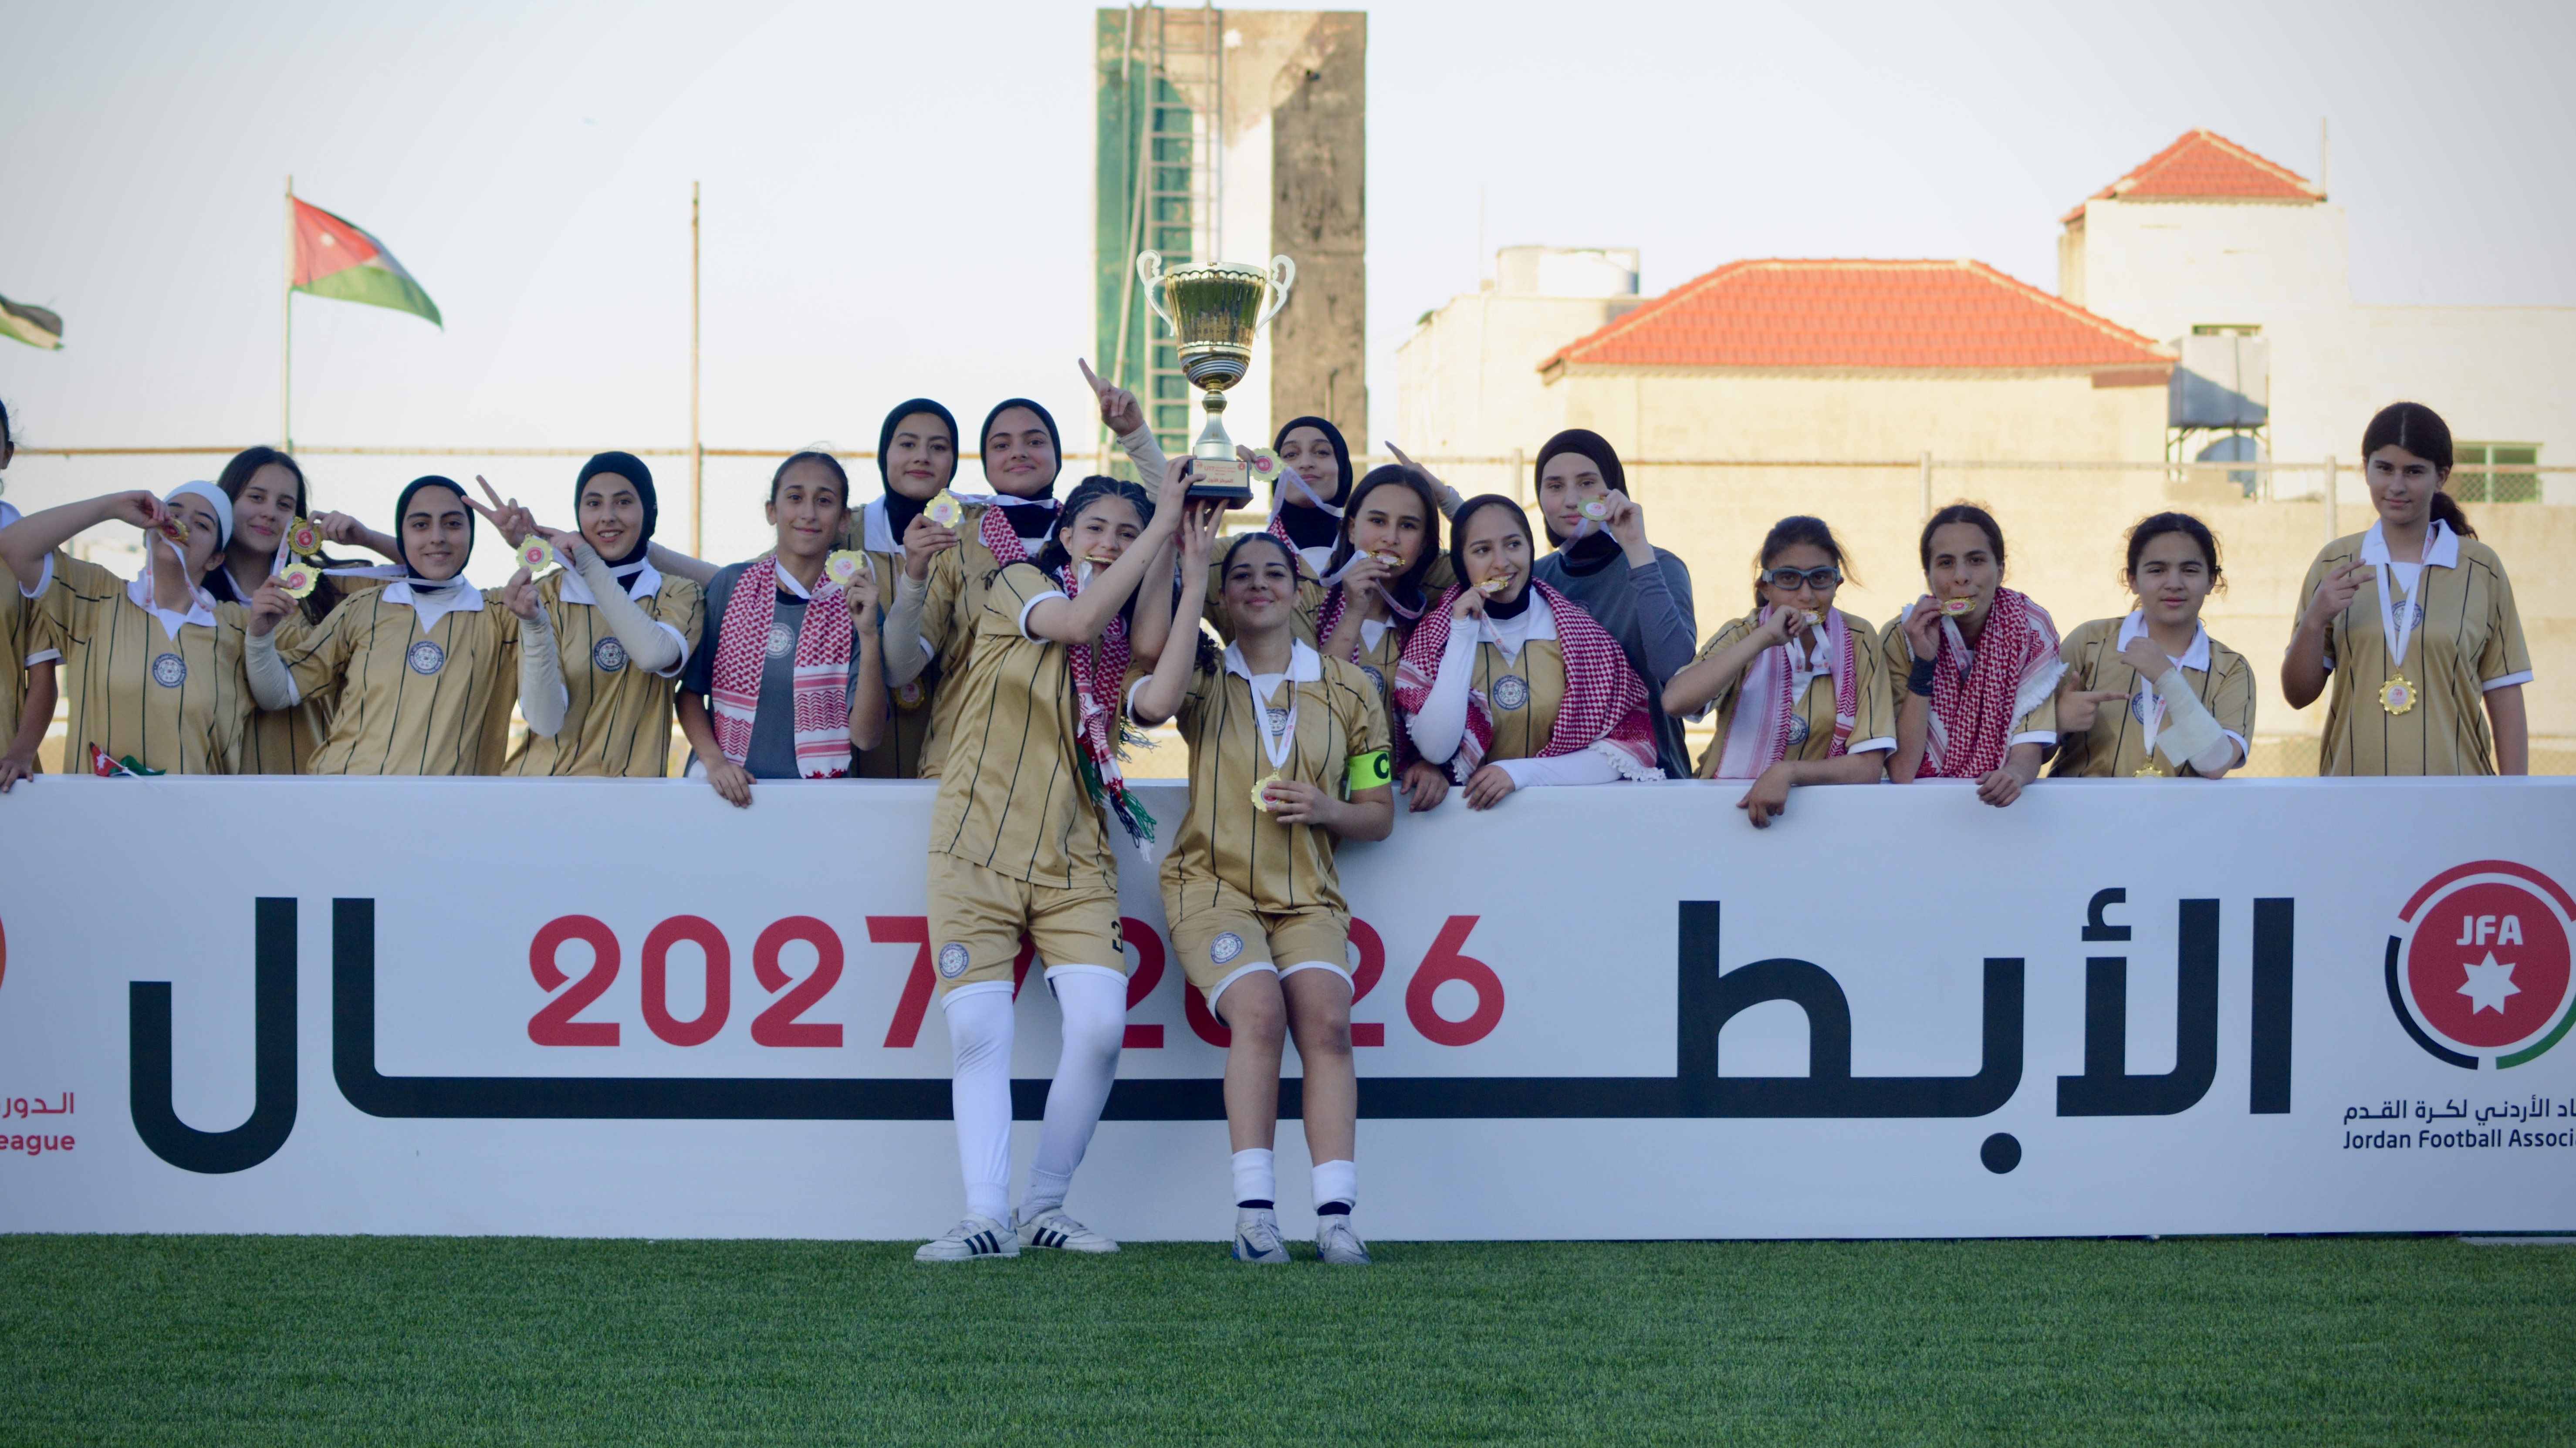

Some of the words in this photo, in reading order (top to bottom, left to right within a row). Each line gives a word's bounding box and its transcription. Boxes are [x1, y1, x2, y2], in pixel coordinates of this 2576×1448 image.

[1373, 753, 1389, 779] C
[2456, 915, 2523, 945] JFA
[0, 1092, 74, 1119] الدور
[2344, 1100, 2407, 1125] القدم
[2415, 1099, 2467, 1124] لكرة
[2475, 1094, 2549, 1126] الأردني
[0, 1134, 75, 1156] eague
[2343, 1130, 2411, 1149] Jordan
[2419, 1129, 2502, 1148] Football
[2508, 1128, 2576, 1148] Associ
